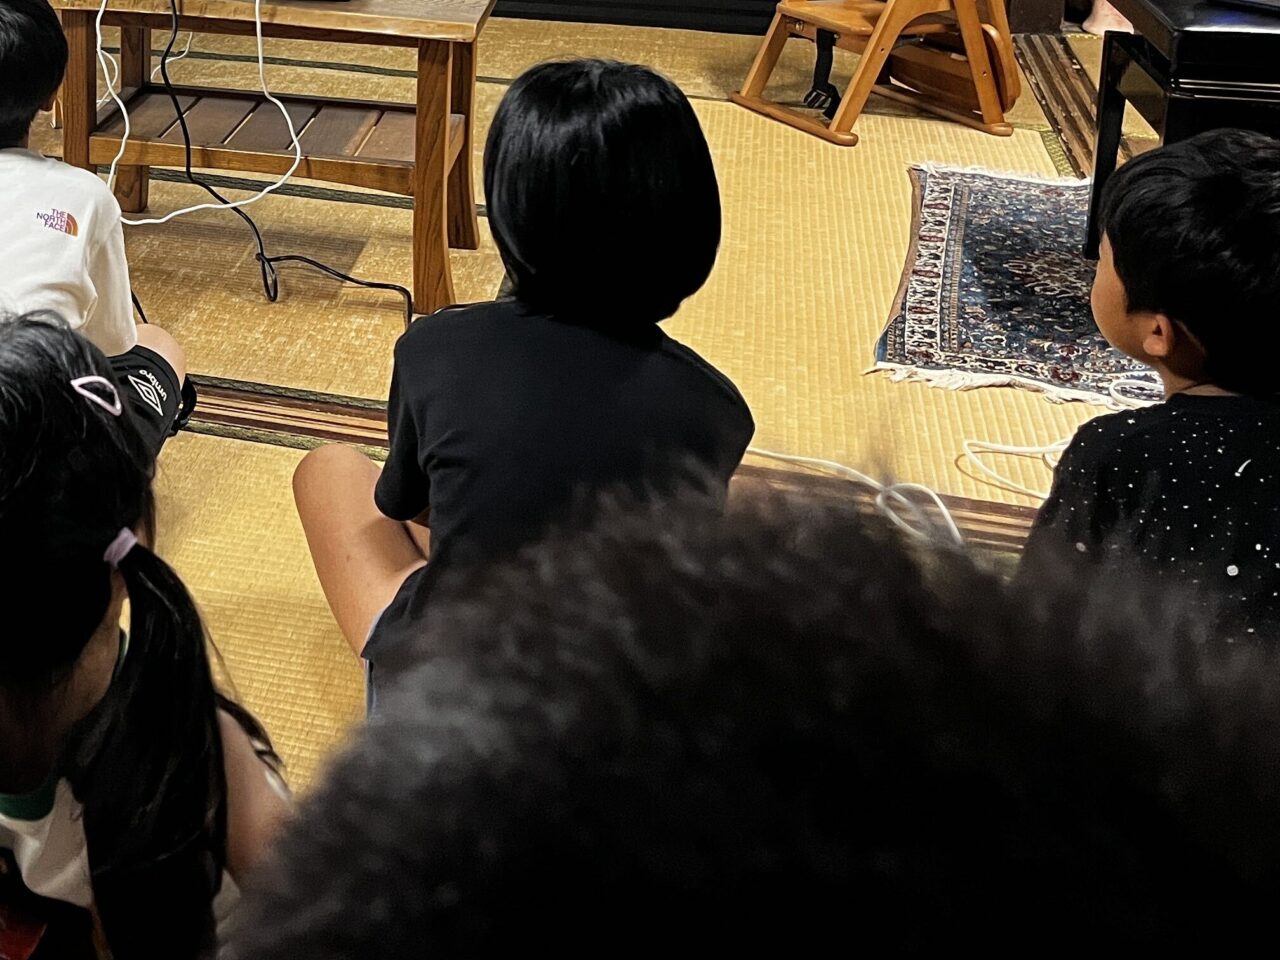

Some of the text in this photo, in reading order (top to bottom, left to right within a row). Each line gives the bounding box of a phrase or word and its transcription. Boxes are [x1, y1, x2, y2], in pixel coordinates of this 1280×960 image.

[36, 212, 66, 225] NORTH
[51, 208, 67, 219] THE
[44, 220, 66, 233] FACE
[138, 369, 167, 401] umbro
